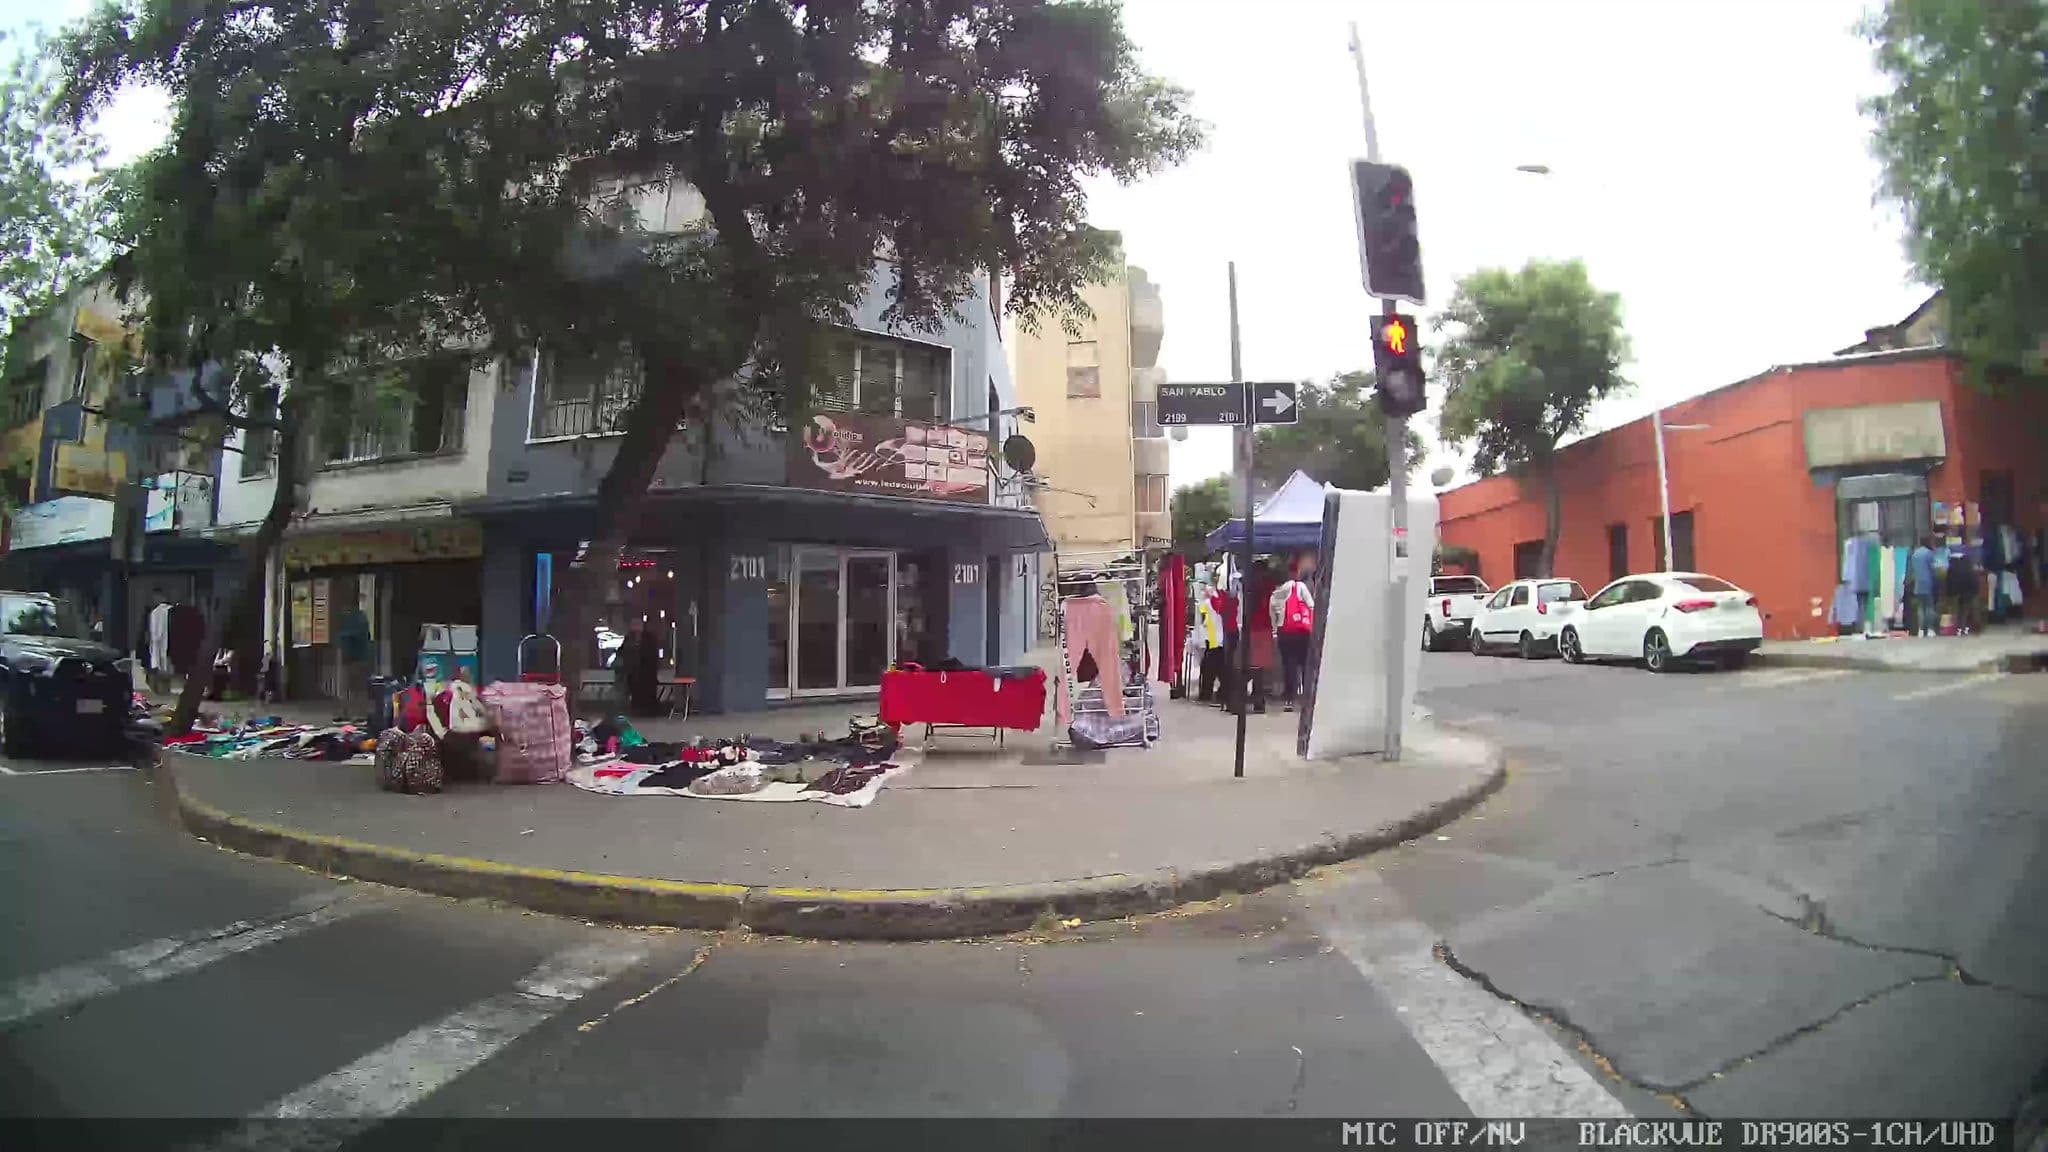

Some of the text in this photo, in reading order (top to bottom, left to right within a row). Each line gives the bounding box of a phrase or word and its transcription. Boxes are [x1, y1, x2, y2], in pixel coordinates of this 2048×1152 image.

[1161, 387, 1227, 397] SAN PABLO
[1218, 412, 1239, 422] 2101
[730, 556, 765, 579] 2101
[954, 564, 979, 583] 2101
